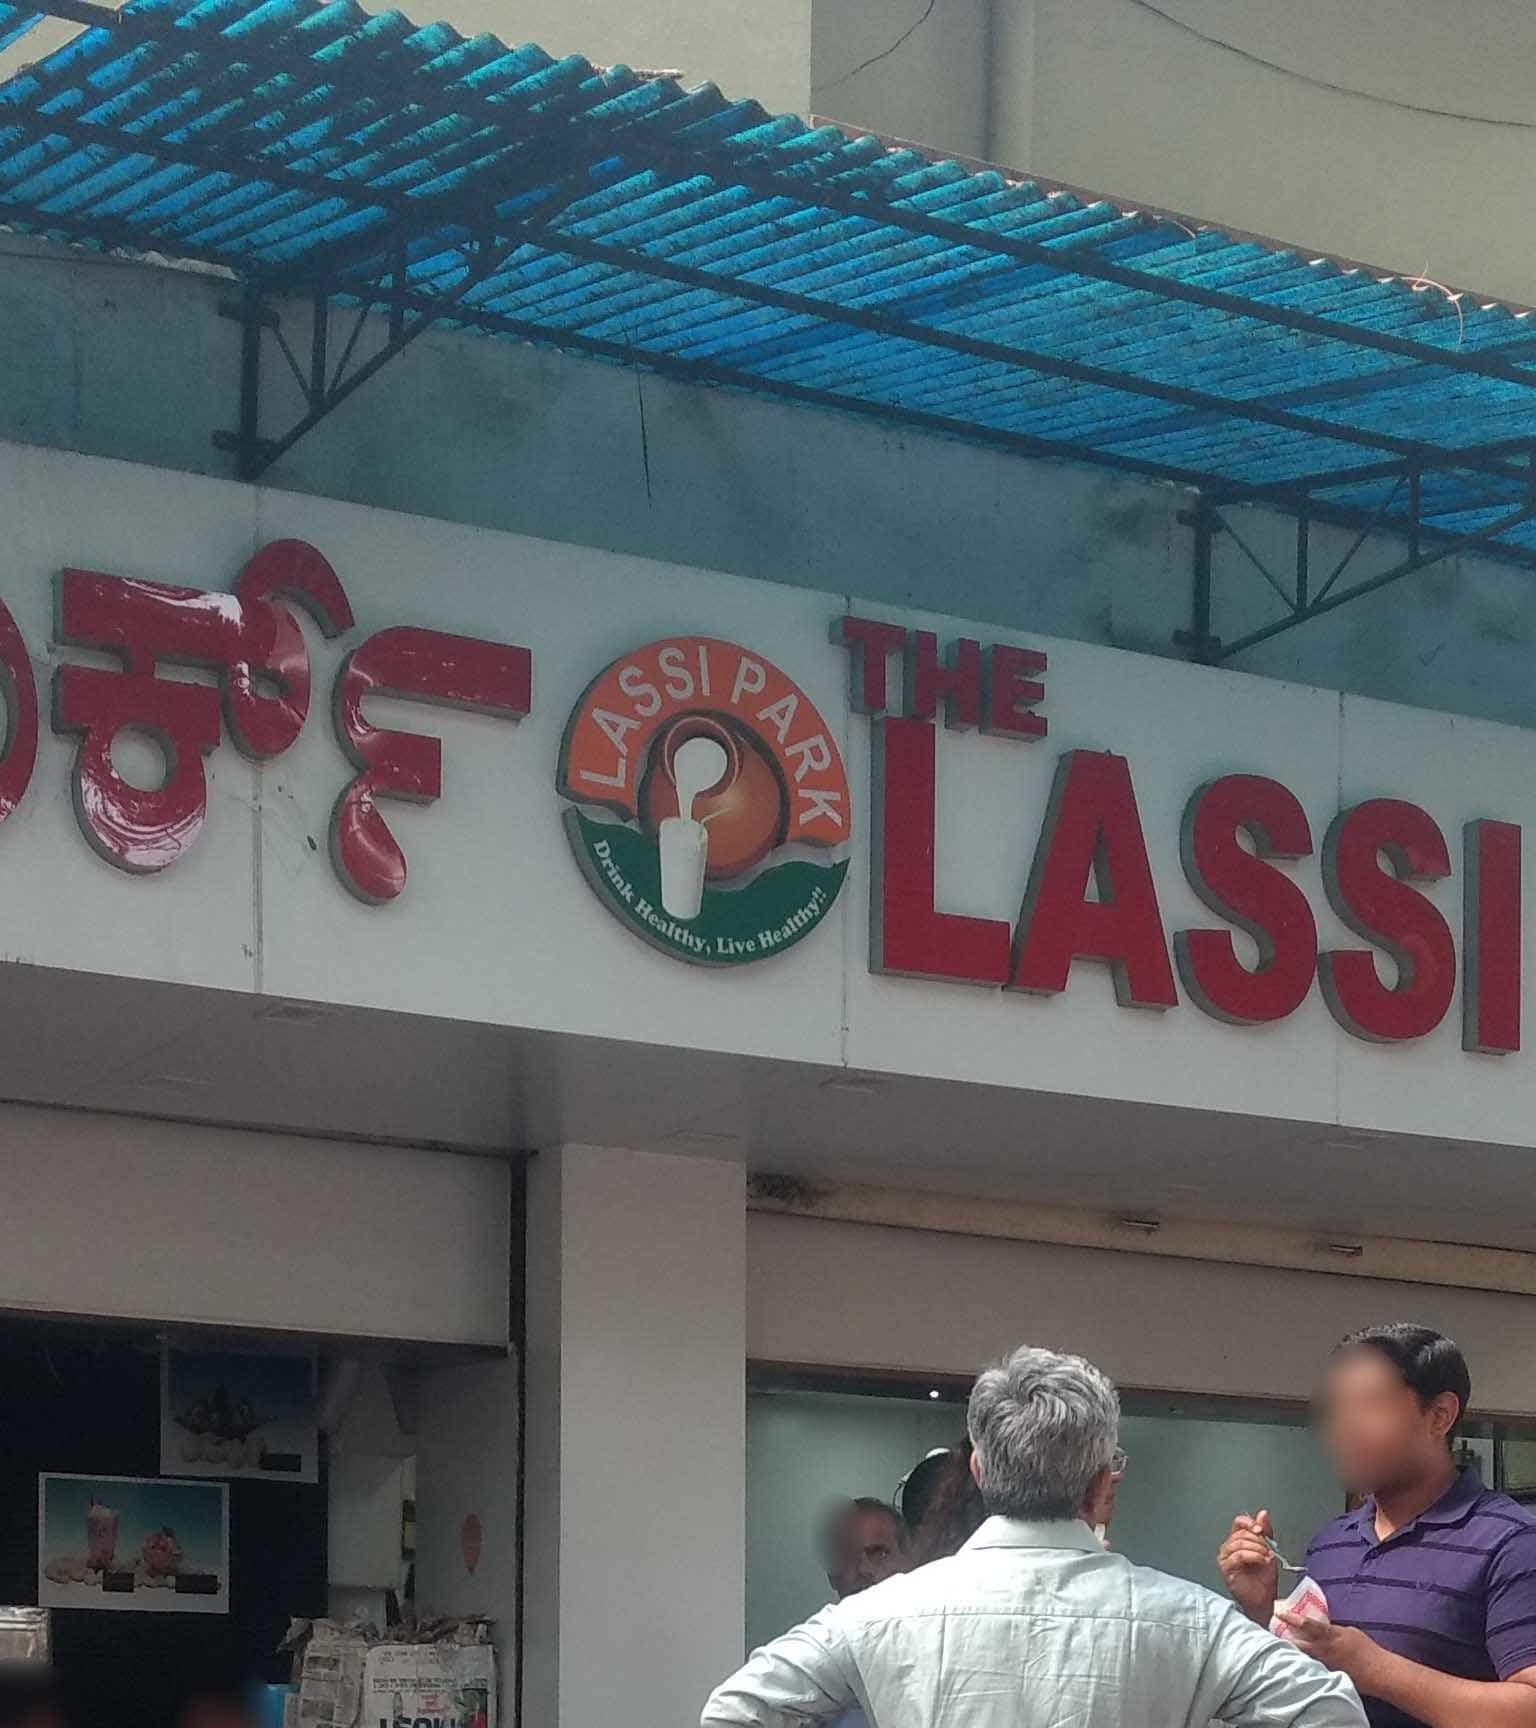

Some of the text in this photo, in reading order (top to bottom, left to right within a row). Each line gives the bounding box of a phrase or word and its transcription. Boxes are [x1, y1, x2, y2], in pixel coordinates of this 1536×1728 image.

[579, 645, 843, 828] LASSI PARK
[838, 617, 1049, 742] THE
[591, 838, 829, 956] Drink Healthy, Live Healthy!!
[869, 715, 1521, 1055] LASSI
